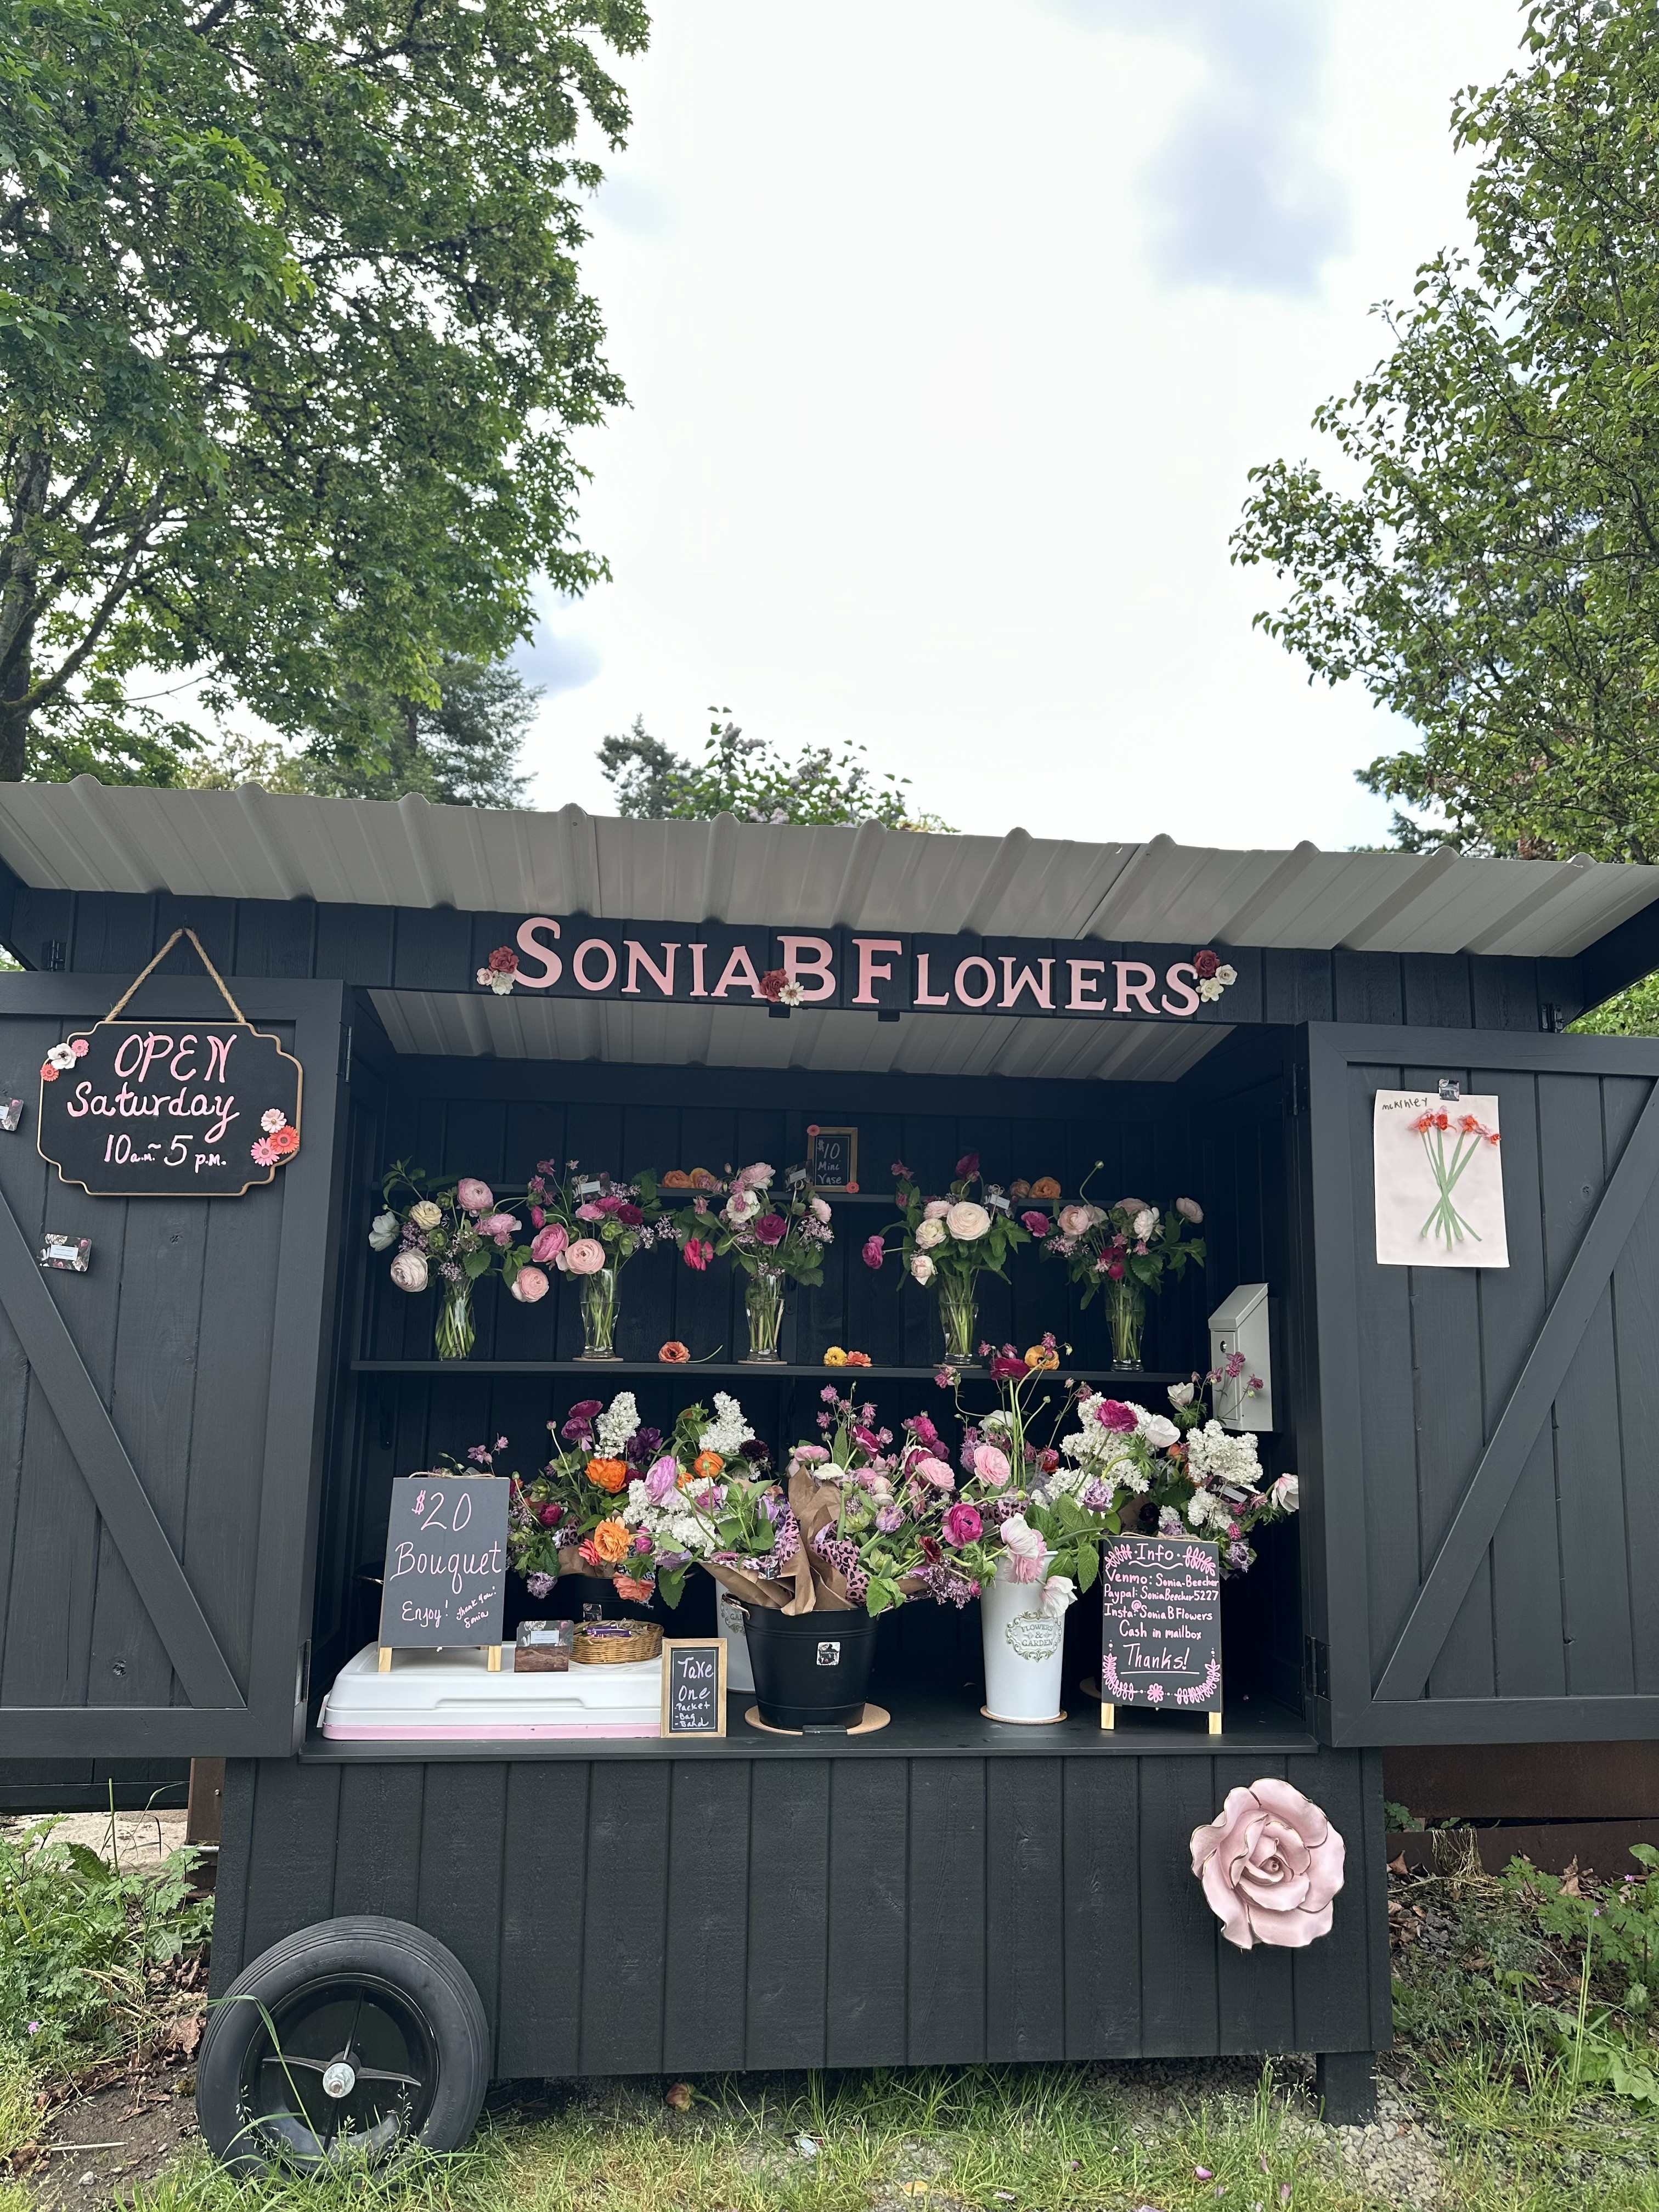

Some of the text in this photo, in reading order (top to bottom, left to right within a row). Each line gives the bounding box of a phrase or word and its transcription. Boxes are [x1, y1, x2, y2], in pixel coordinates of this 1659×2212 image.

[114, 1031, 238, 1083] OPEN
[66, 1081, 240, 1143] Saturday
[816, 1139, 840, 1159] $10
[817, 1173, 842, 1185] Vase
[411, 1490, 472, 1532] $20
[390, 1541, 502, 1594] Bouquet
[1105, 1568, 1220, 1588] Venmo: Sonia-Beecher
[1104, 1583, 1138, 1604] Paypal:
[402, 1600, 449, 1628] Enjoy!
[464, 1611, 489, 1628] Sonia
[1104, 1602, 1137, 1618] Insta:
[1021, 1624, 1053, 1633] FLOWERS
[1119, 1619, 1202, 1640] Cash in mailbox
[1022, 1638, 1053, 1646] GARDEN
[1122, 1643, 1190, 1671] Thanks!
[677, 1657, 714, 1679] Take
[678, 1685, 710, 1702] One
